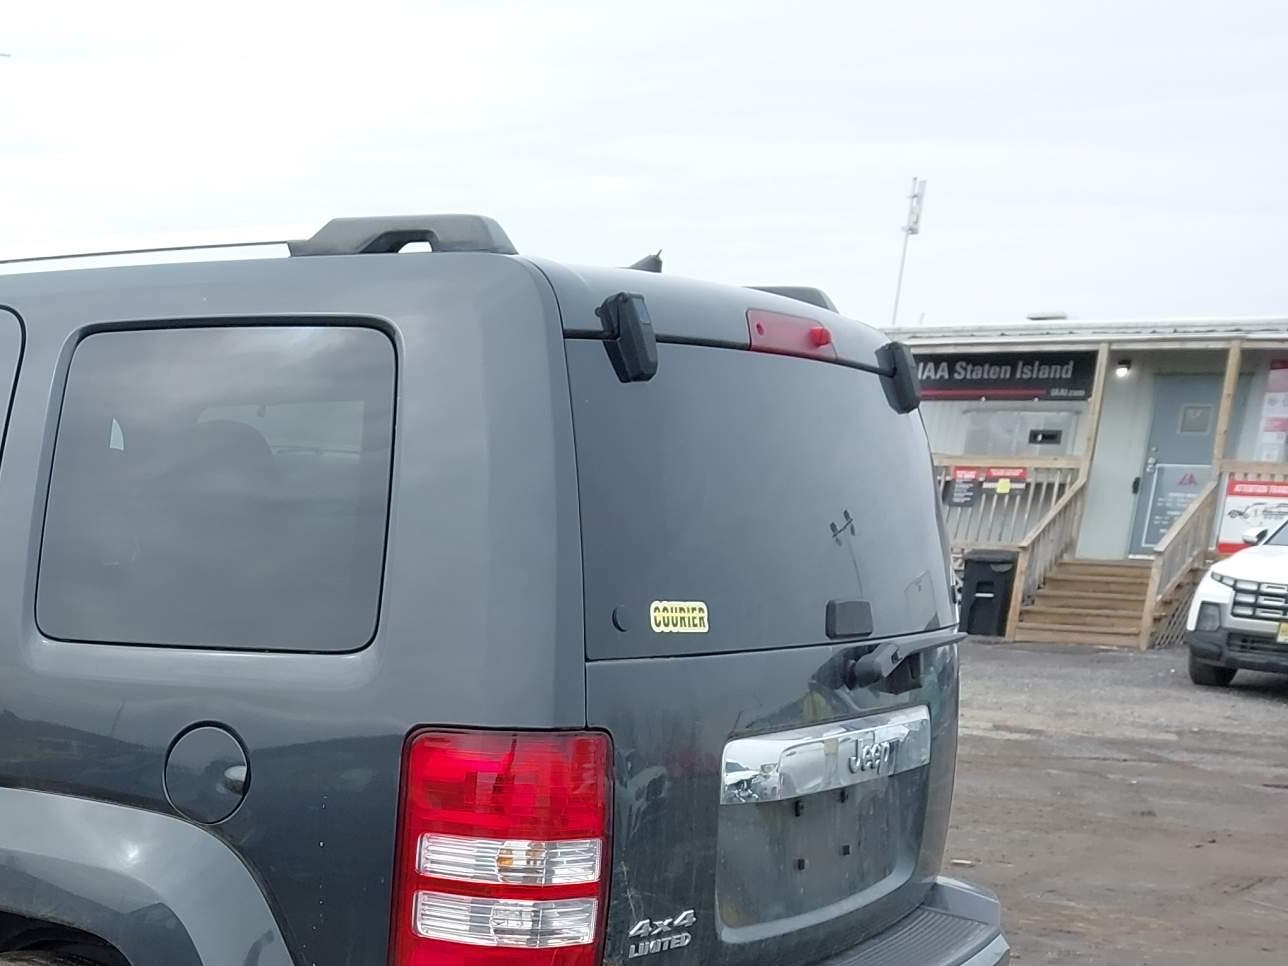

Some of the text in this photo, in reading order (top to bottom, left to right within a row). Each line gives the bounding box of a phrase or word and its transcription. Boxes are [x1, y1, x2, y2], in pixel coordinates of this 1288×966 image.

[917, 360, 1074, 380] IAA Staten Island
[653, 606, 706, 628] COURIER
[848, 739, 892, 775] Jeep
[629, 932, 692, 958] LIMITED
